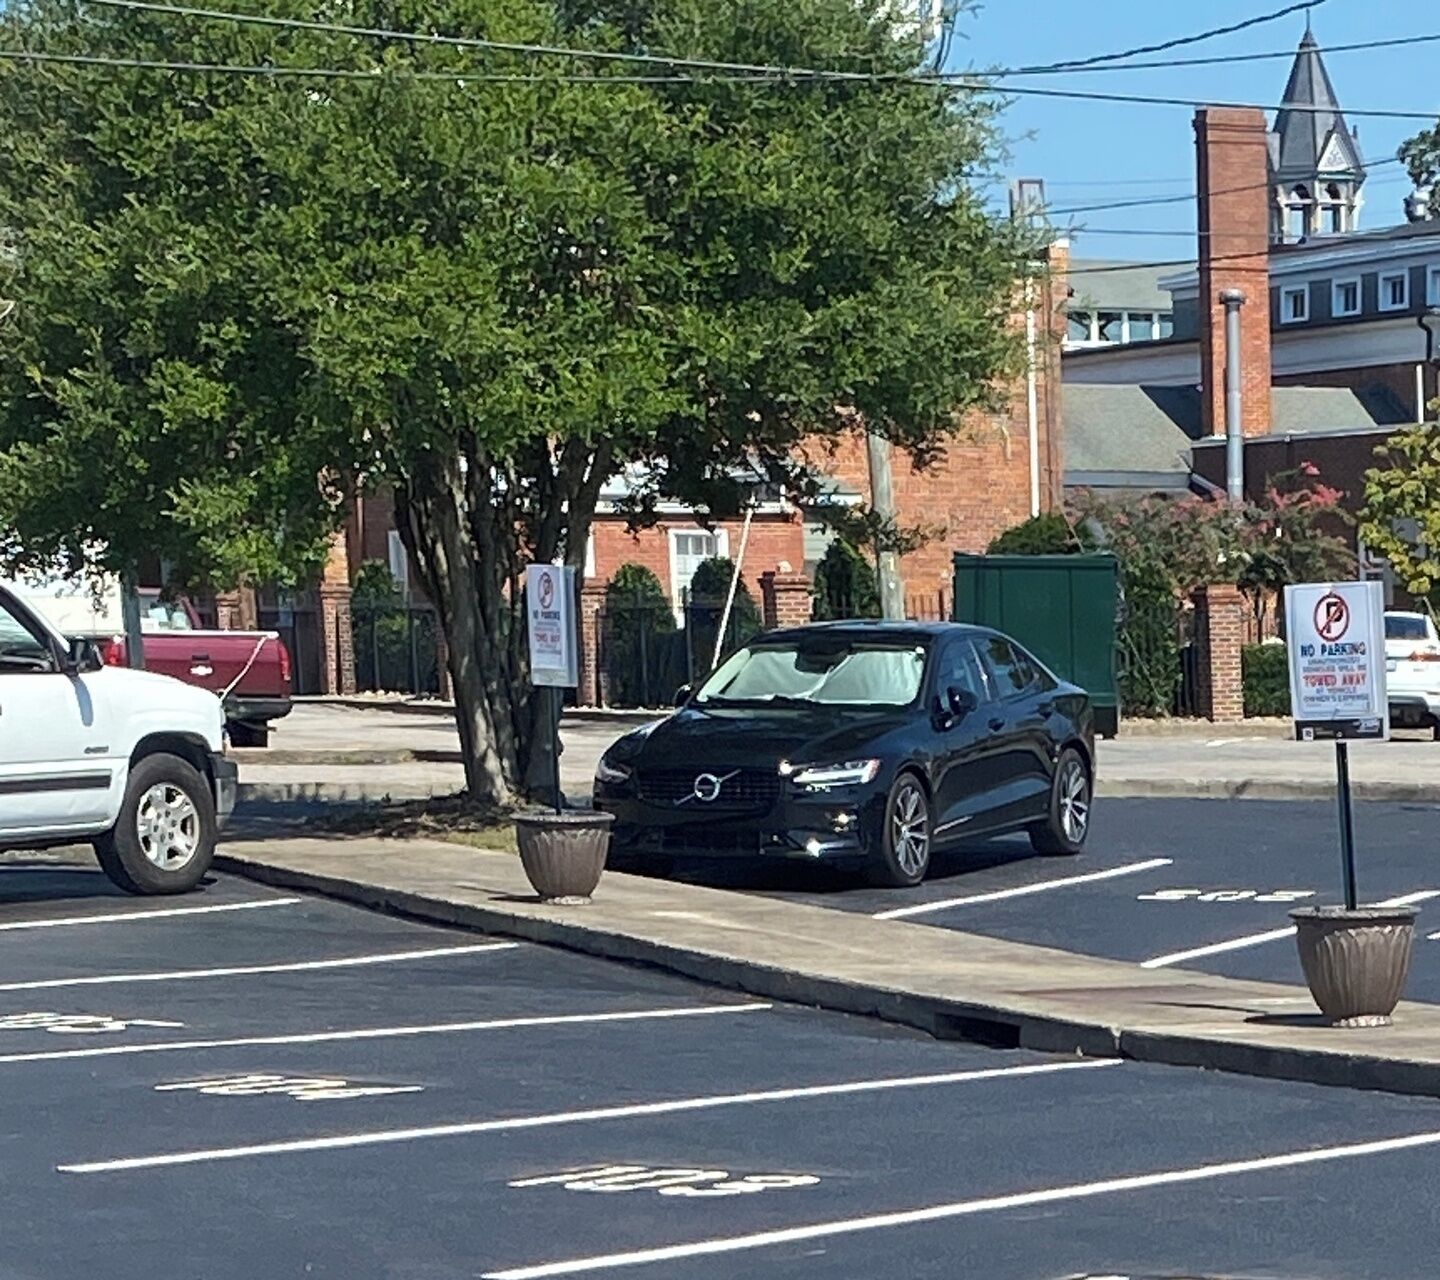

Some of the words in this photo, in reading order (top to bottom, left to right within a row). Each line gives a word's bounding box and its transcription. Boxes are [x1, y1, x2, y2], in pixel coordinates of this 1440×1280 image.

[1301, 644, 1315, 657] NO
[1321, 642, 1366, 655] PARKING
[1303, 674, 1337, 687] TOWED
[1342, 673, 1366, 686] AWAY
[506, 1165, 821, 1197] 103
